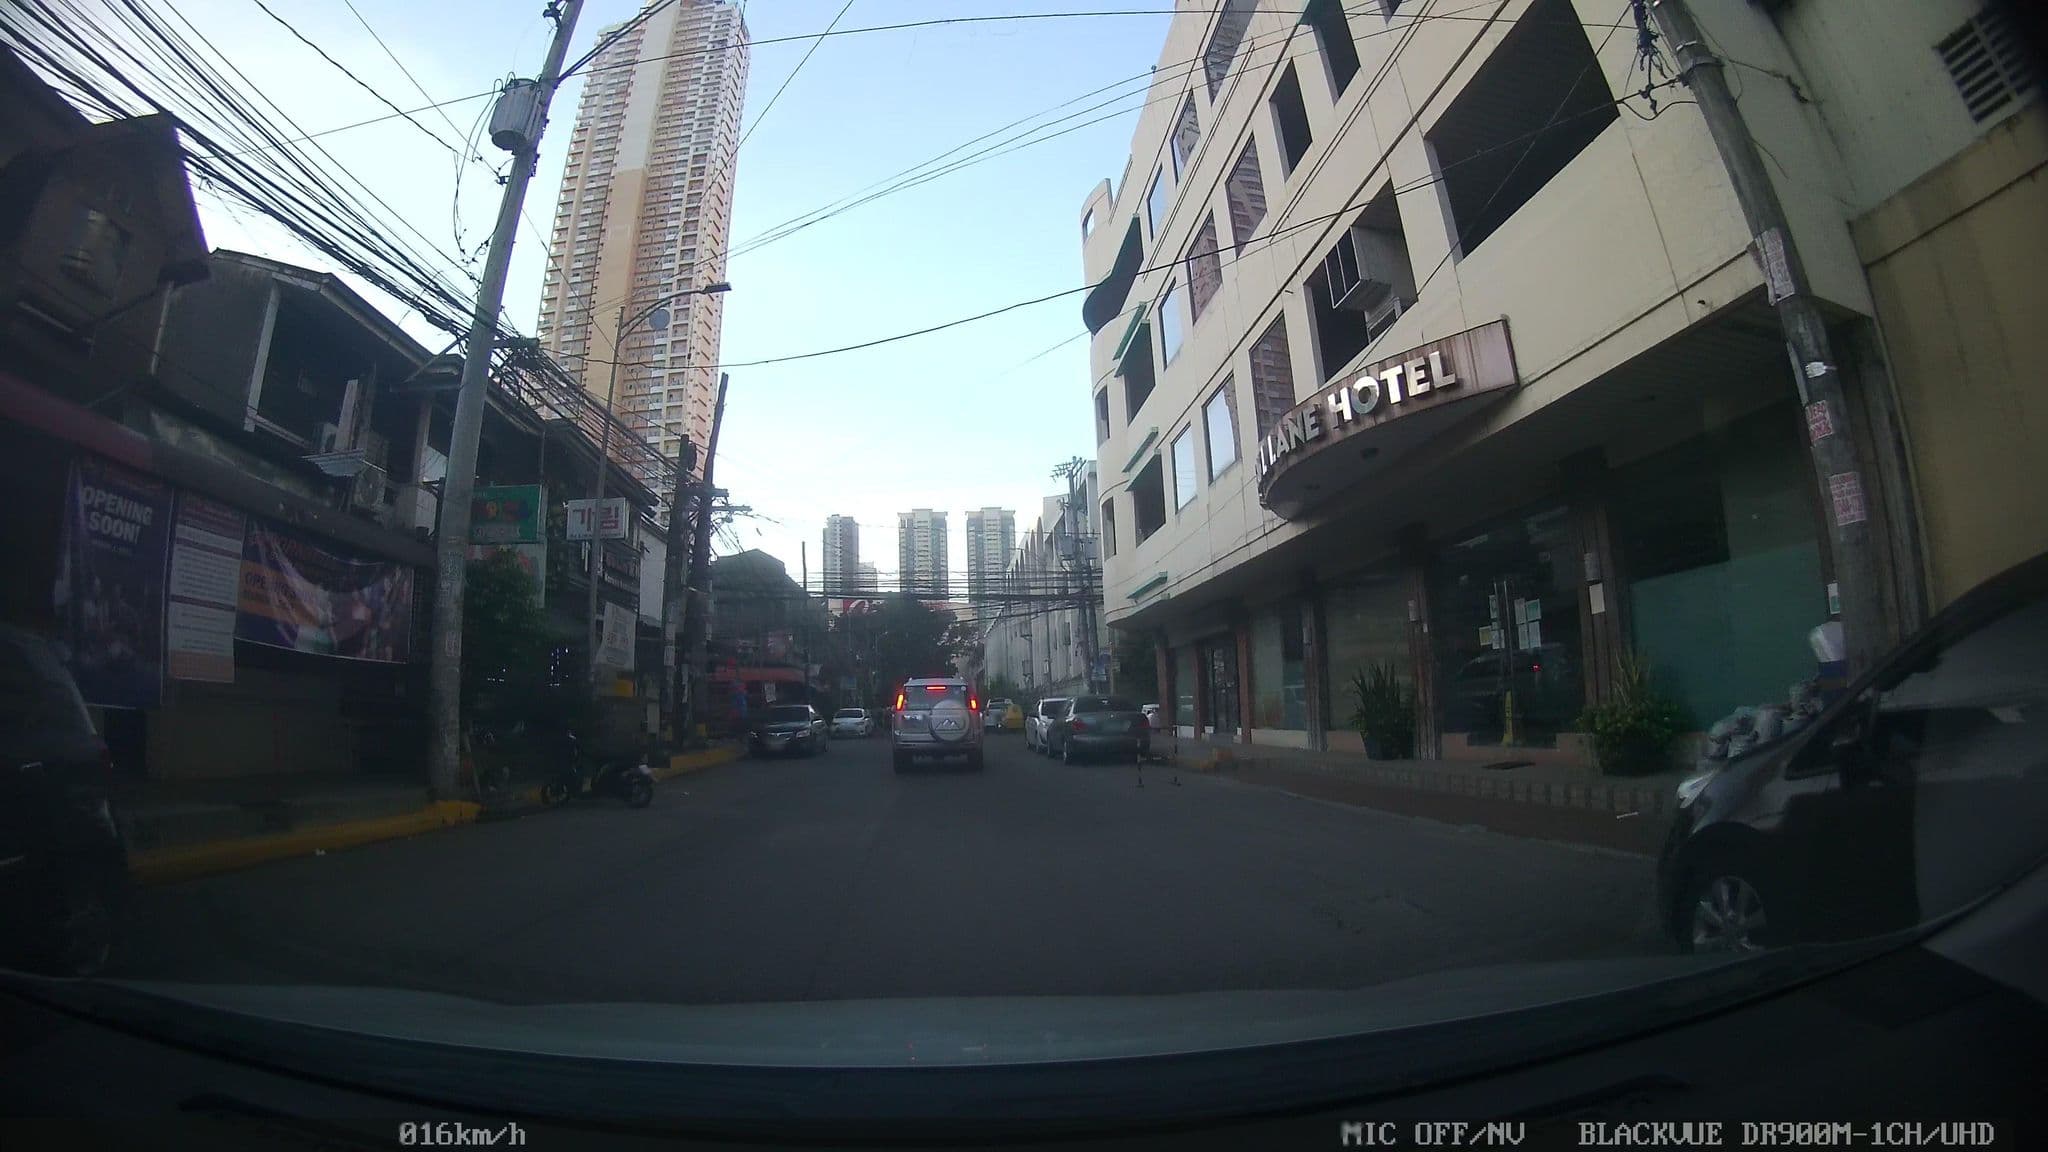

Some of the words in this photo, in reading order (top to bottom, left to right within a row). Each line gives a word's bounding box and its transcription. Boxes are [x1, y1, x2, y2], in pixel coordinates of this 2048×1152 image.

[1327, 351, 1456, 430] HOTEL
[81, 485, 153, 527] OPENING
[89, 511, 141, 545] SOON!
